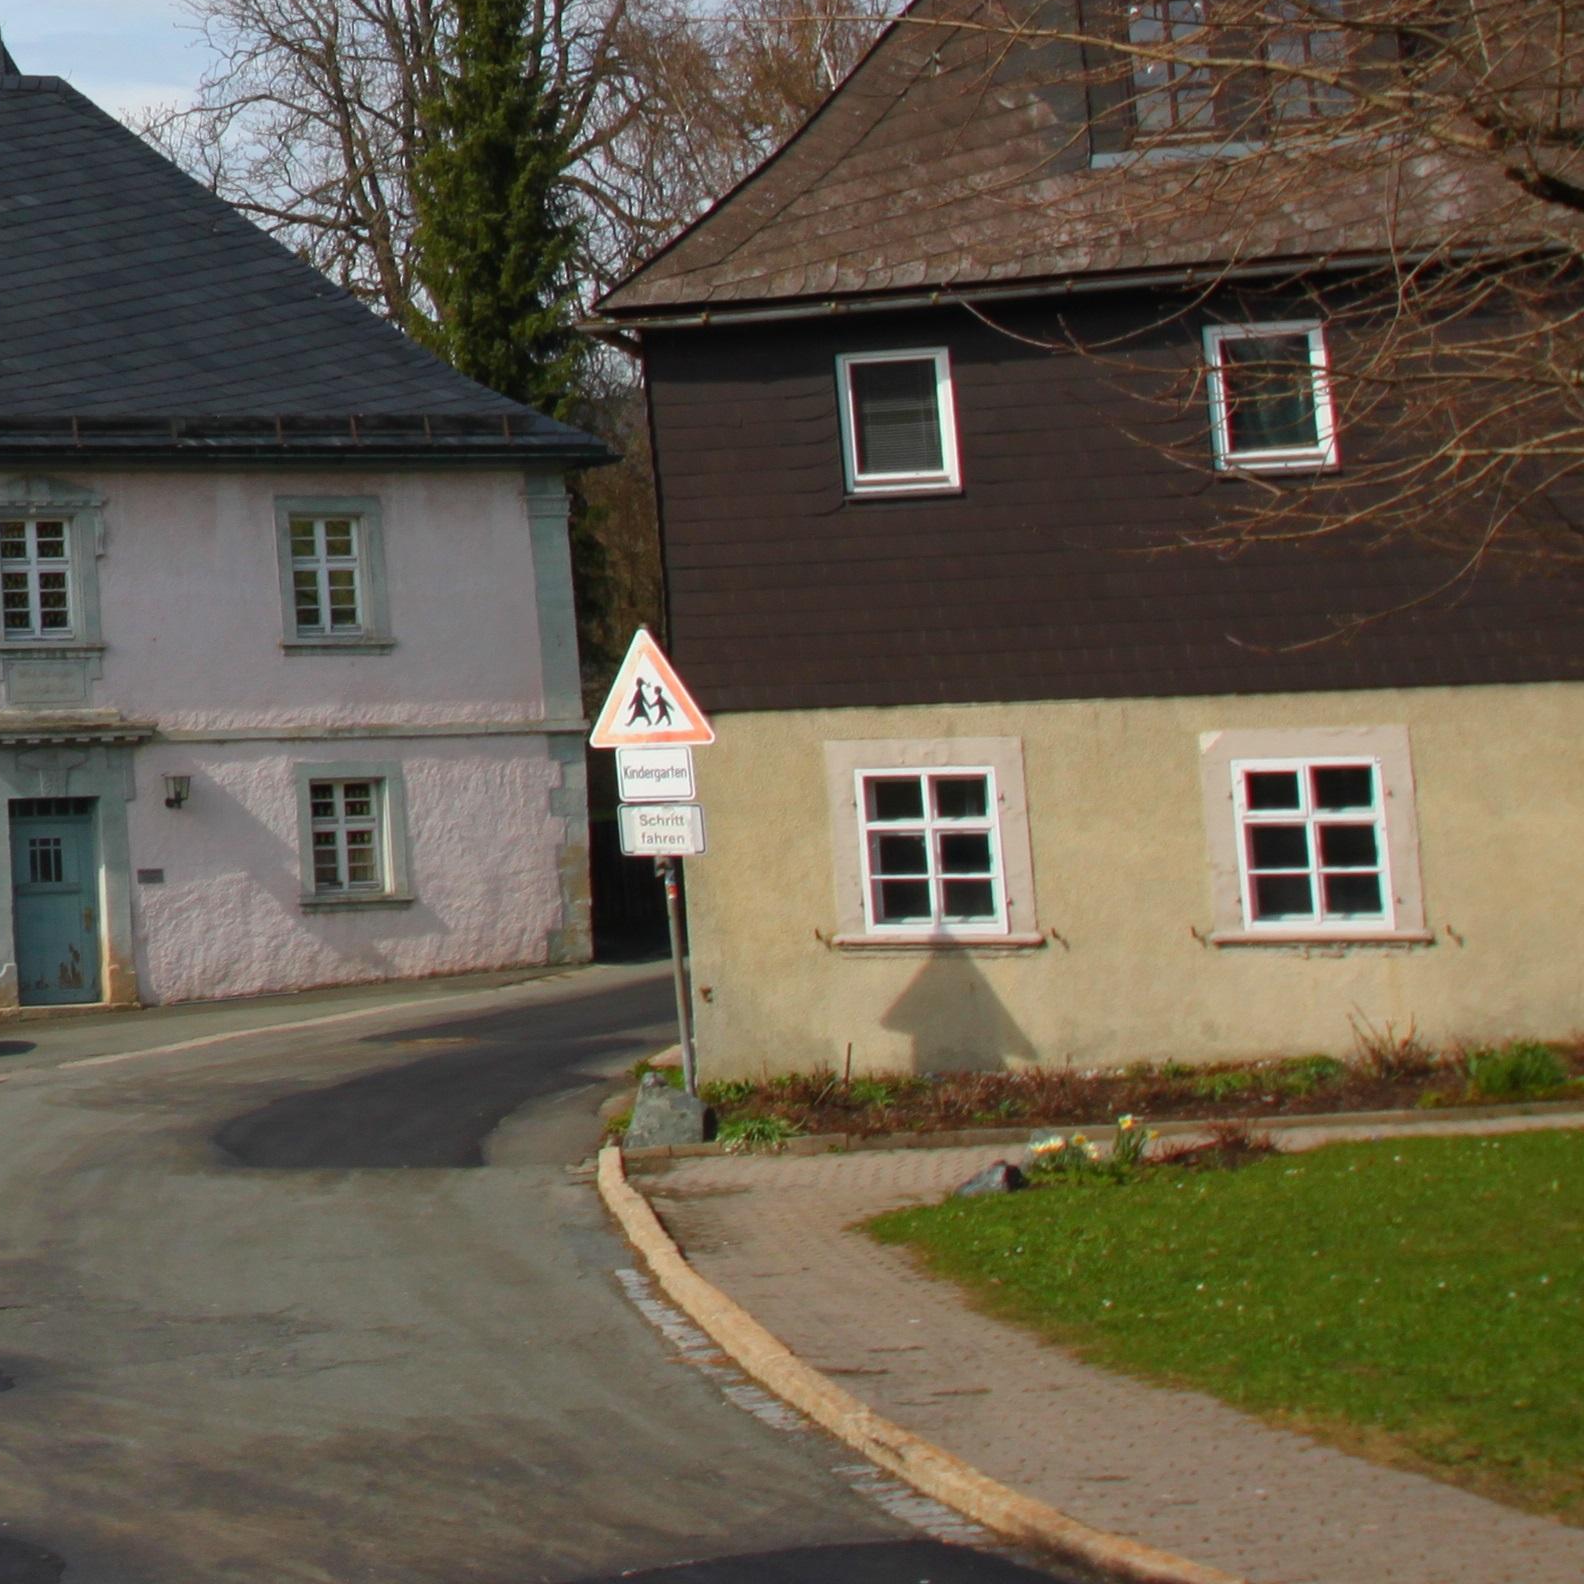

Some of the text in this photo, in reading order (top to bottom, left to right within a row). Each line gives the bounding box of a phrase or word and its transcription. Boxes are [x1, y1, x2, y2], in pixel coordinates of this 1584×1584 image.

[623, 766, 687, 782] Kindergarten
[639, 813, 684, 826] Schritt
[641, 832, 685, 845] fahren
